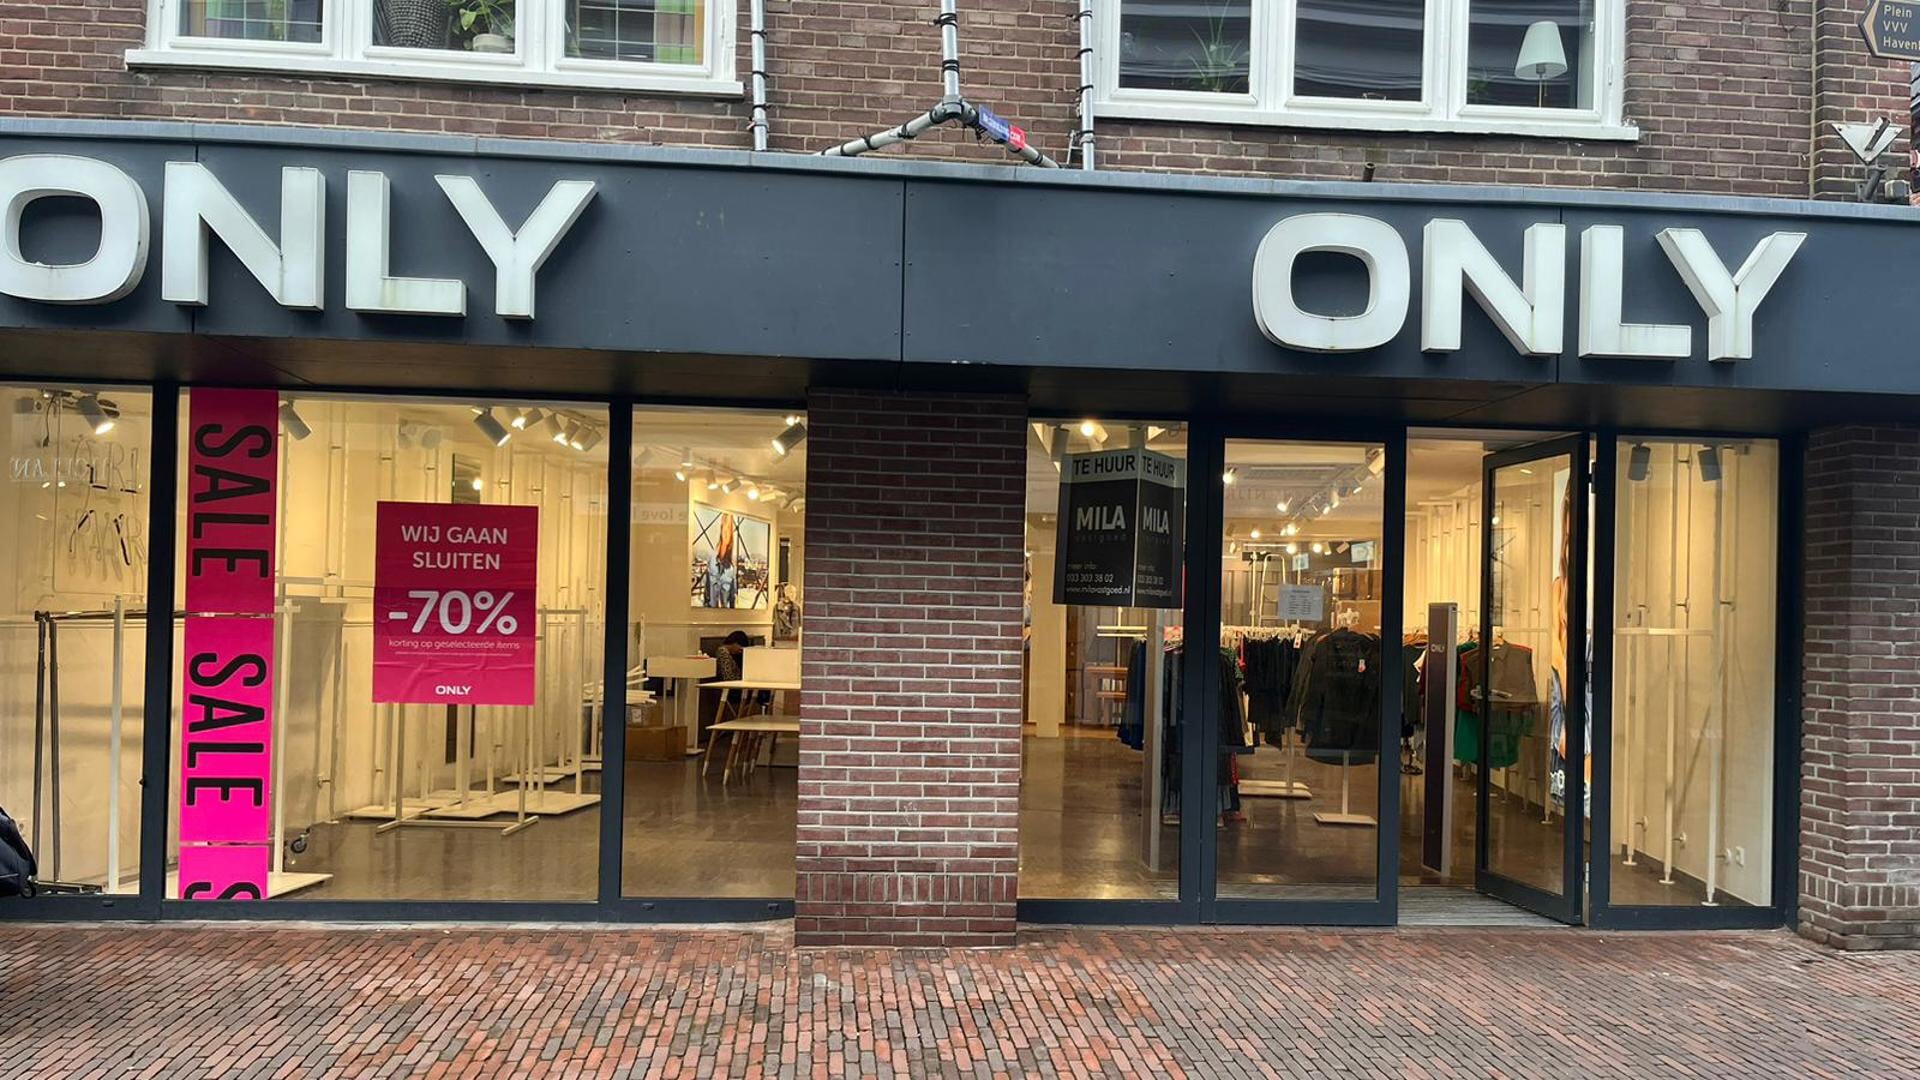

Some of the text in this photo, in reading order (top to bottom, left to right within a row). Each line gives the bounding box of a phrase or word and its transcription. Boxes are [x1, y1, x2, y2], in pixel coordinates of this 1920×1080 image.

[1883, 4, 1913, 18] Plein
[1883, 20, 1908, 33] VVV
[0, 153, 598, 320] ONLY
[1252, 212, 1808, 361] ONLY
[1073, 455, 1136, 475] TE HUUR
[1143, 456, 1176, 480] TE HUUR
[192, 423, 272, 578] SALE
[1076, 505, 1127, 531] MILA
[1142, 506, 1170, 534] MILA
[401, 525, 508, 544] WIJ GAAN
[412, 552, 501, 570] SLUITEN
[388, 590, 518, 636] -70%
[388, 638, 418, 650] korting
[420, 640, 433, 649] op
[435, 685, 472, 696] ONLY
[186, 652, 267, 807] SALE
